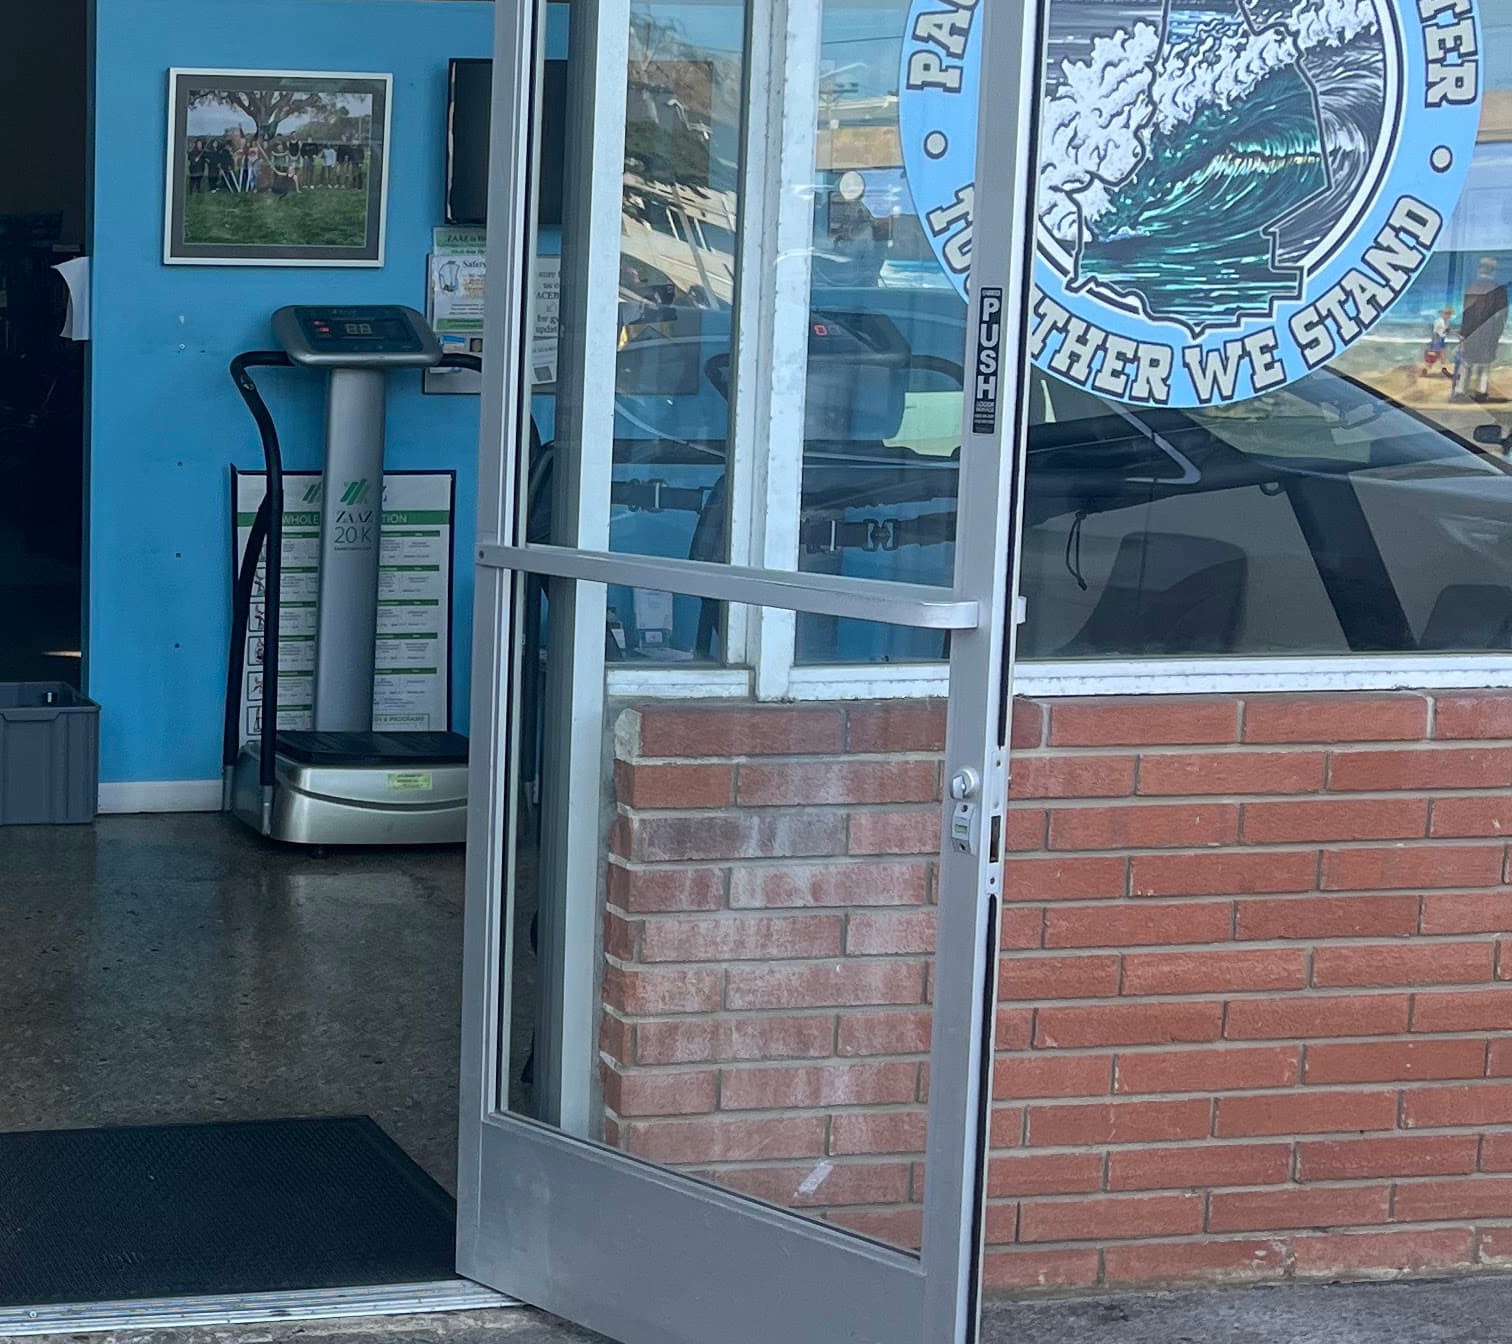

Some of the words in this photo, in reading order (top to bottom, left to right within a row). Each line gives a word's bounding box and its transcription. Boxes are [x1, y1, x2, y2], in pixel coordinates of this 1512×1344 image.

[976, 297, 1000, 400] PUSH
[1185, 326, 1287, 405] WE
[1288, 194, 1445, 369] STAND
